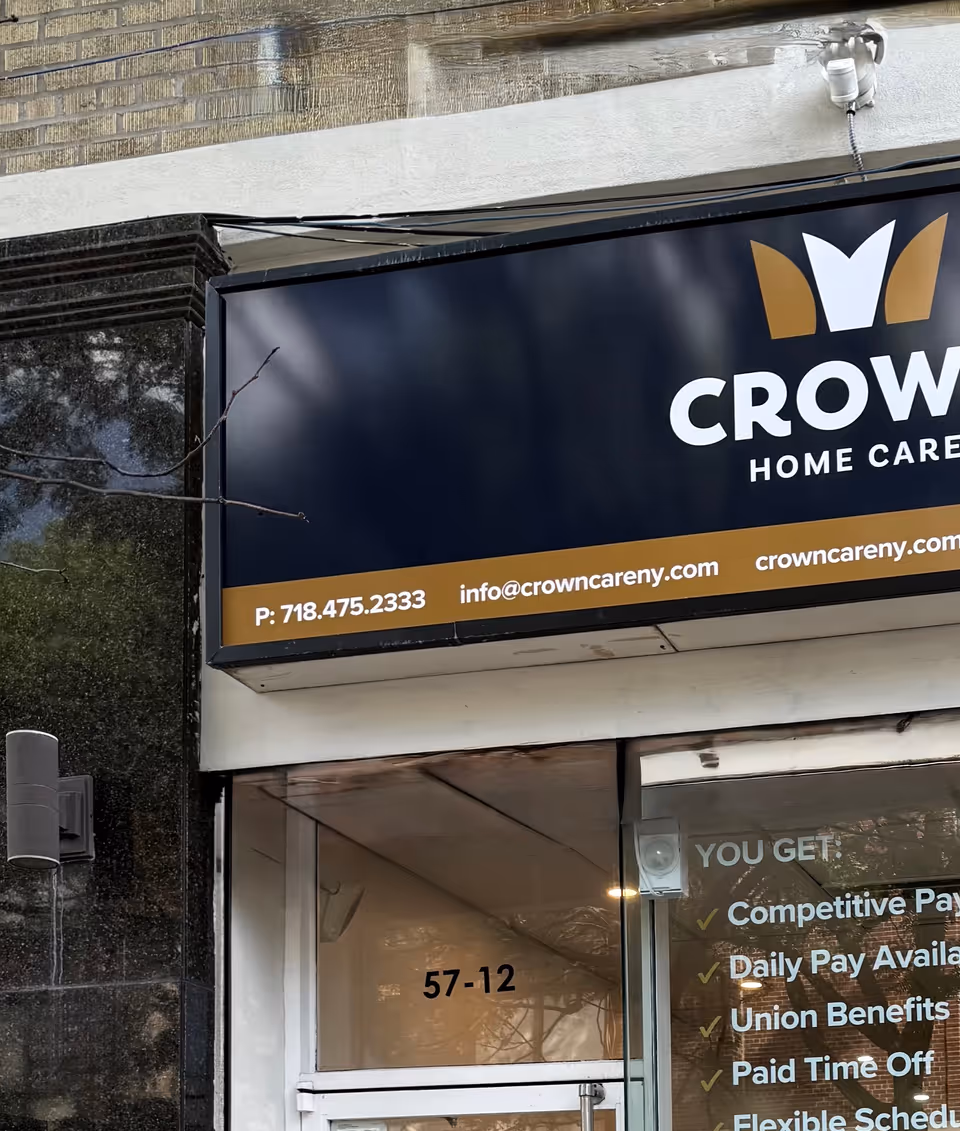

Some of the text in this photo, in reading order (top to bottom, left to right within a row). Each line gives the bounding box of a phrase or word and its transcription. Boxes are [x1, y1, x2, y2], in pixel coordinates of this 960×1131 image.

[750, 448, 853, 482] HOME
[255, 606, 275, 626] P:
[281, 590, 426, 623] 718.475.2333
[459, 557, 718, 605] info@crowncareny.com
[695, 835, 843, 868] YOU GET:
[727, 891, 907, 932] Competitive
[423, 964, 515, 999] 57-12
[729, 951, 803, 984] Daily
[810, 946, 866, 980] Pay
[731, 996, 951, 1033] Union Benefits
[732, 1050, 935, 1086] Paid Time Off
